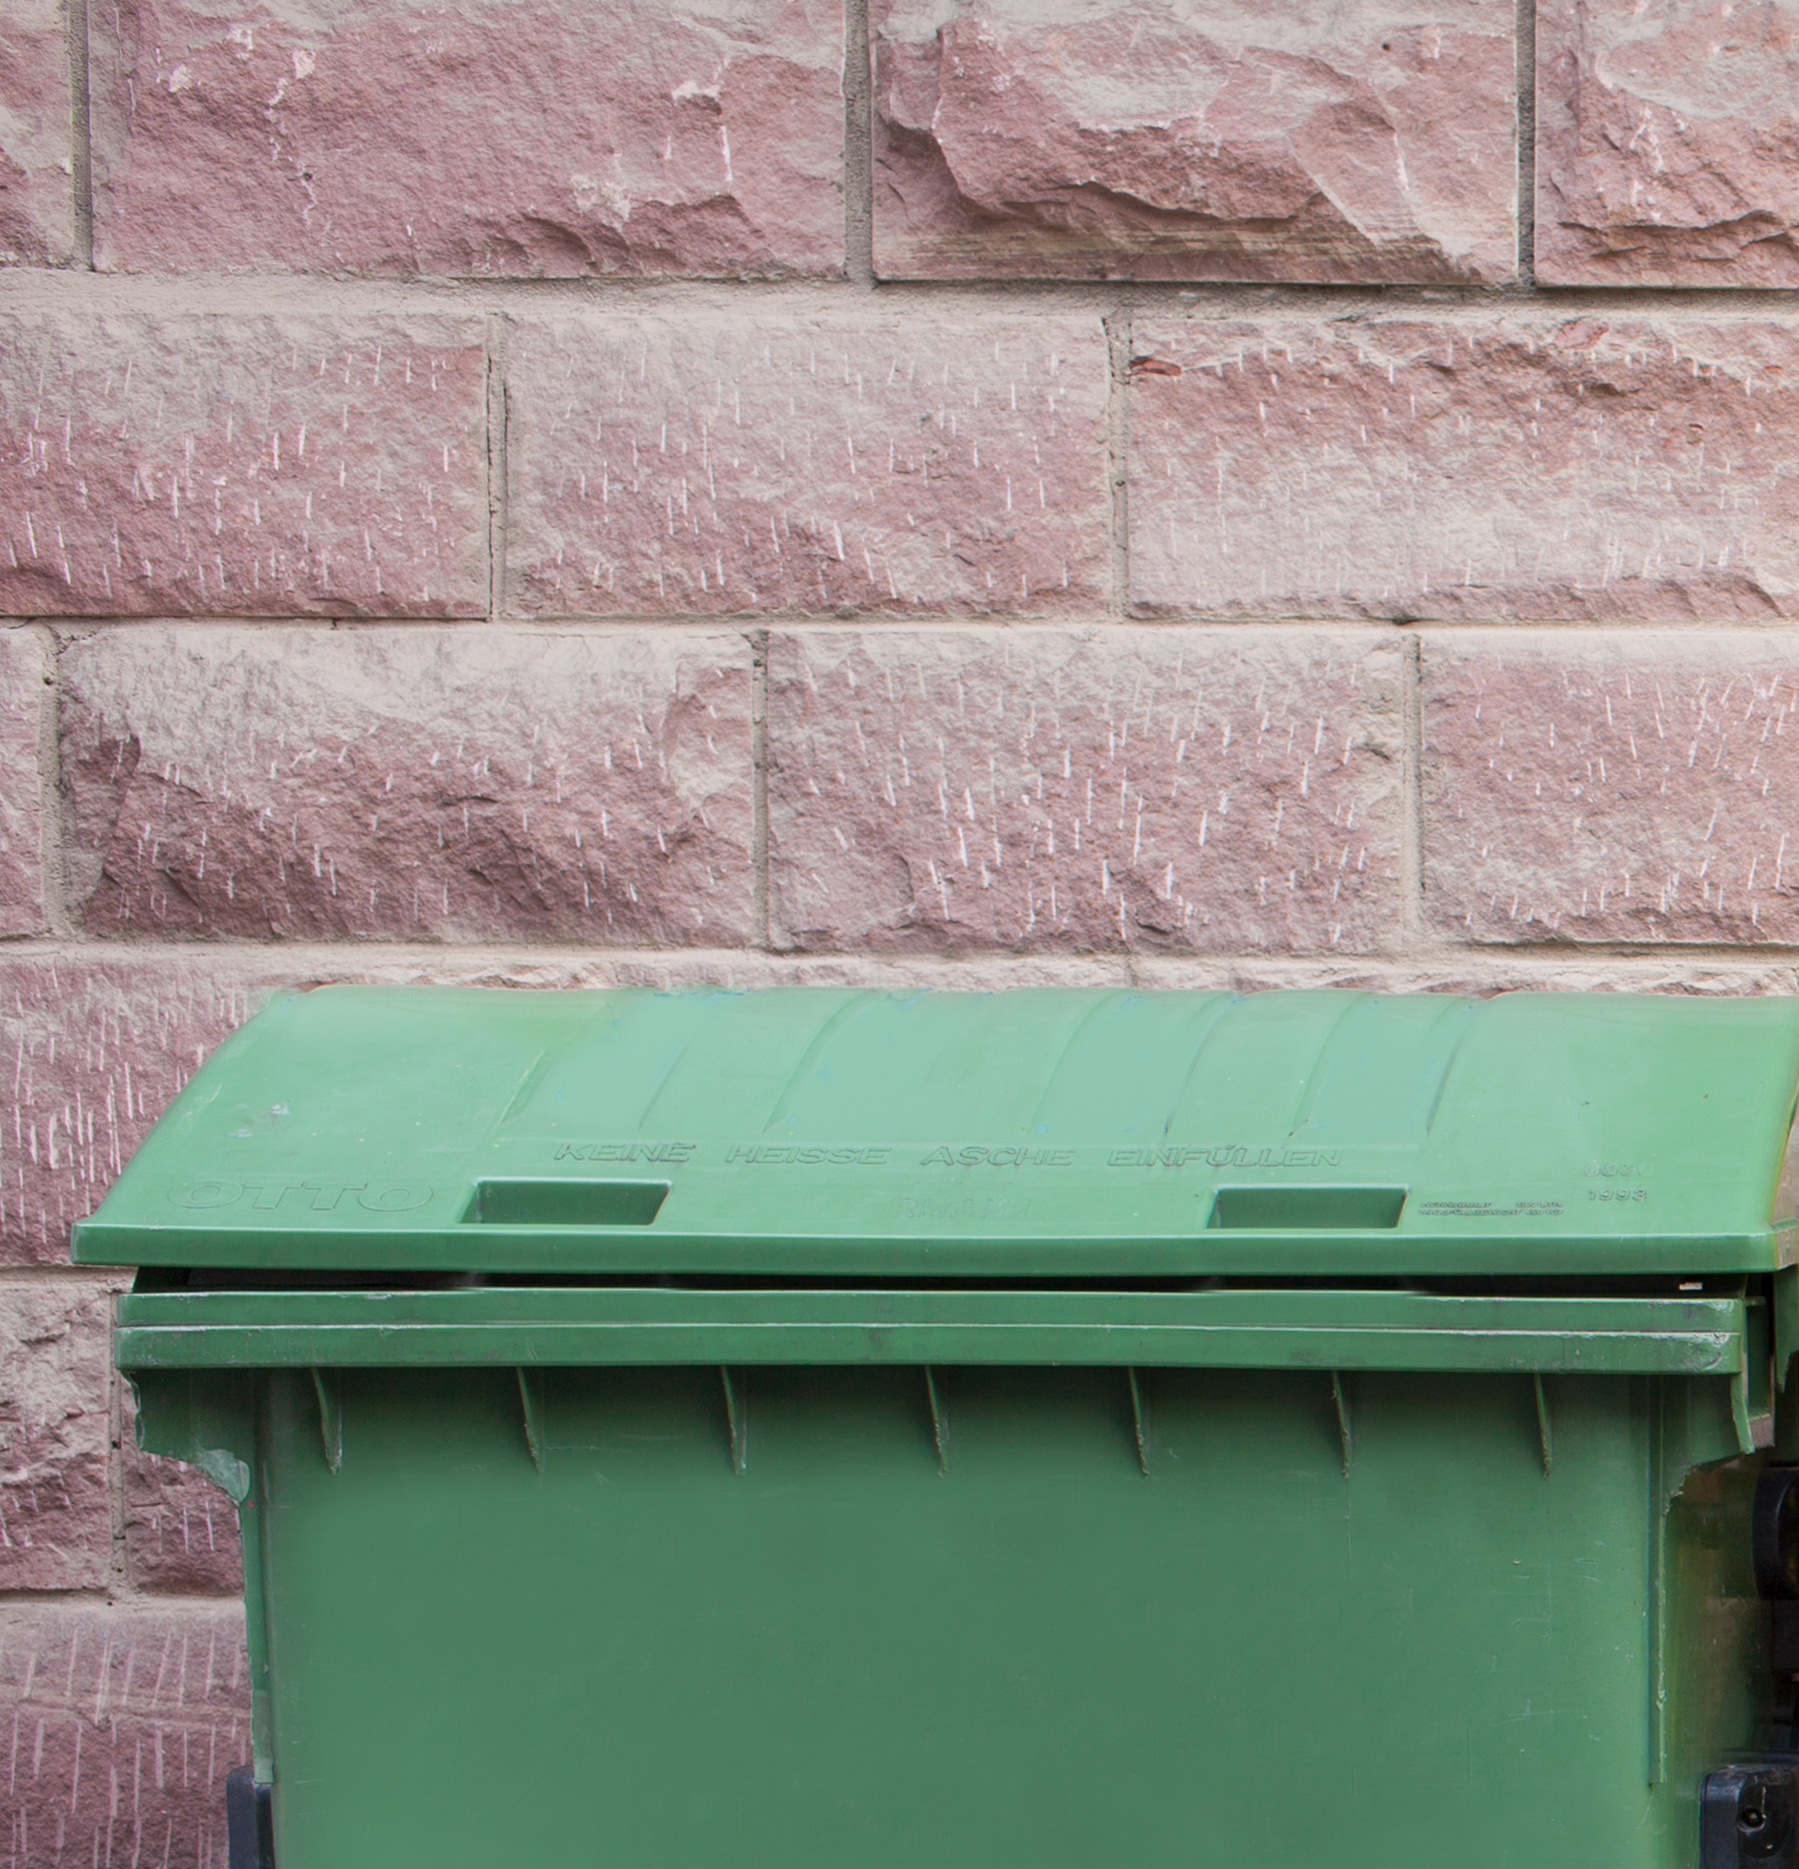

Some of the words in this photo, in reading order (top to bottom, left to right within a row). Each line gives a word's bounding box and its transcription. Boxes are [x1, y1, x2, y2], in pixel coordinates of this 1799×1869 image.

[553, 1141, 698, 1163] KEINE
[724, 1144, 893, 1166] HEISSE
[919, 1145, 1077, 1168] ASCHE
[1106, 1143, 1344, 1168] EINFÜLLEN
[167, 1179, 435, 1213] OTTO
[1588, 1187, 1648, 1202] 1993
